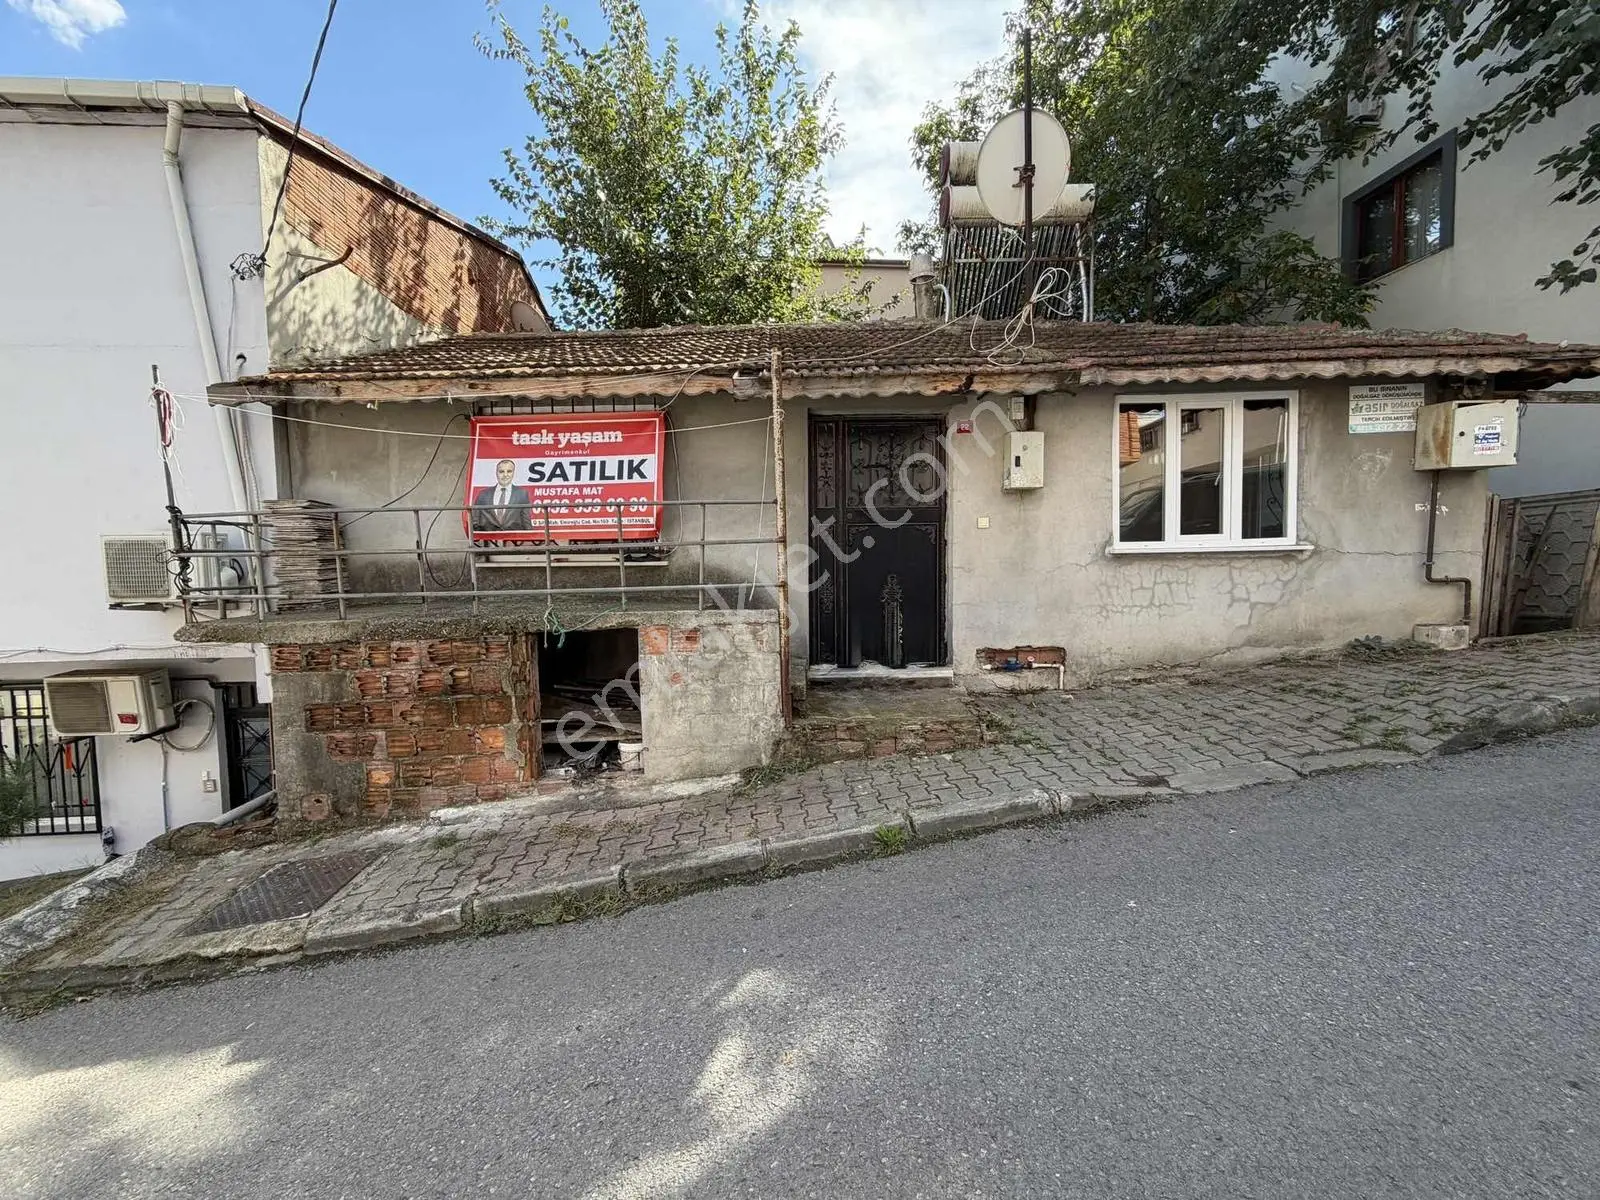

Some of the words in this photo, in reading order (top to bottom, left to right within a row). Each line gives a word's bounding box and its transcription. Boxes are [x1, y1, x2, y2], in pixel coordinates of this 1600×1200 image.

[512, 429, 554, 446] task
[557, 430, 623, 448] yaşam
[528, 458, 649, 483] SATILIK
[534, 487, 579, 497] MUSTAFA
[582, 486, 604, 495] MAT
